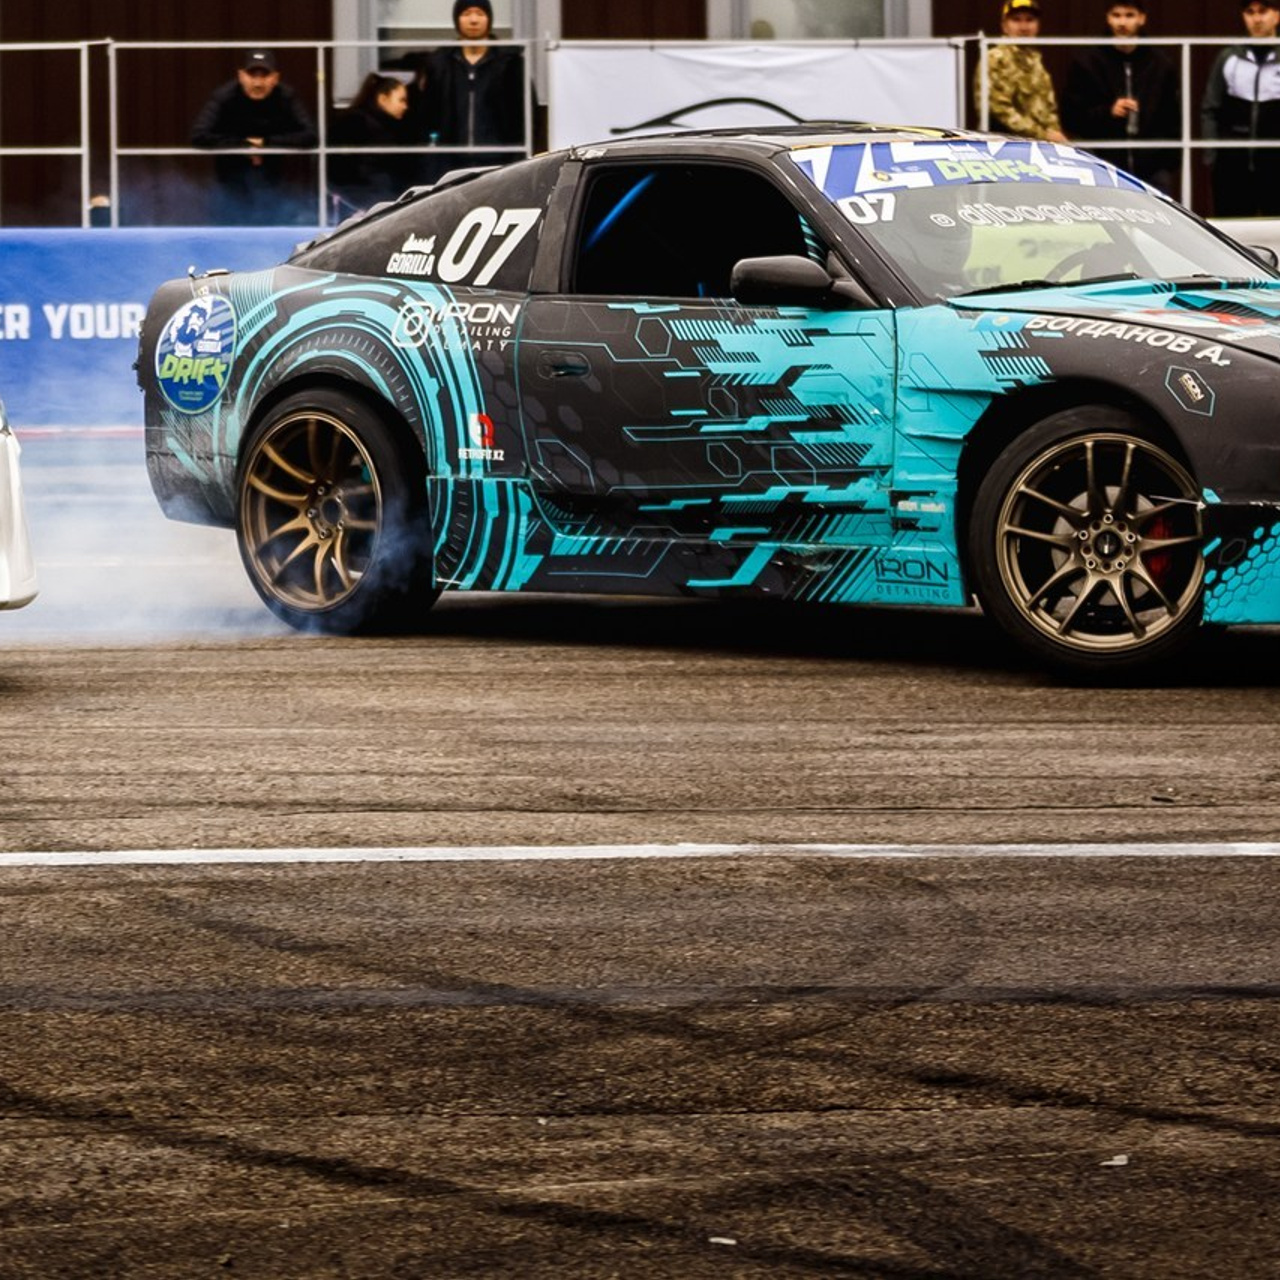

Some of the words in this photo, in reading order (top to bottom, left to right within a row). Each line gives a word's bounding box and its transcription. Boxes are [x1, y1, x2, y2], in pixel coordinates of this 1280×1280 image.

[837, 191, 897, 225] 07
[437, 206, 542, 286] 07
[386, 252, 436, 276] GORILLA
[42, 303, 146, 340] YOUR
[437, 303, 521, 324] IRON
[433, 325, 513, 338] DTAILING
[1025, 315, 1198, 354] БОГДАНОВ
[159, 353, 228, 389] DRIFT
[873, 558, 949, 581] IRON
